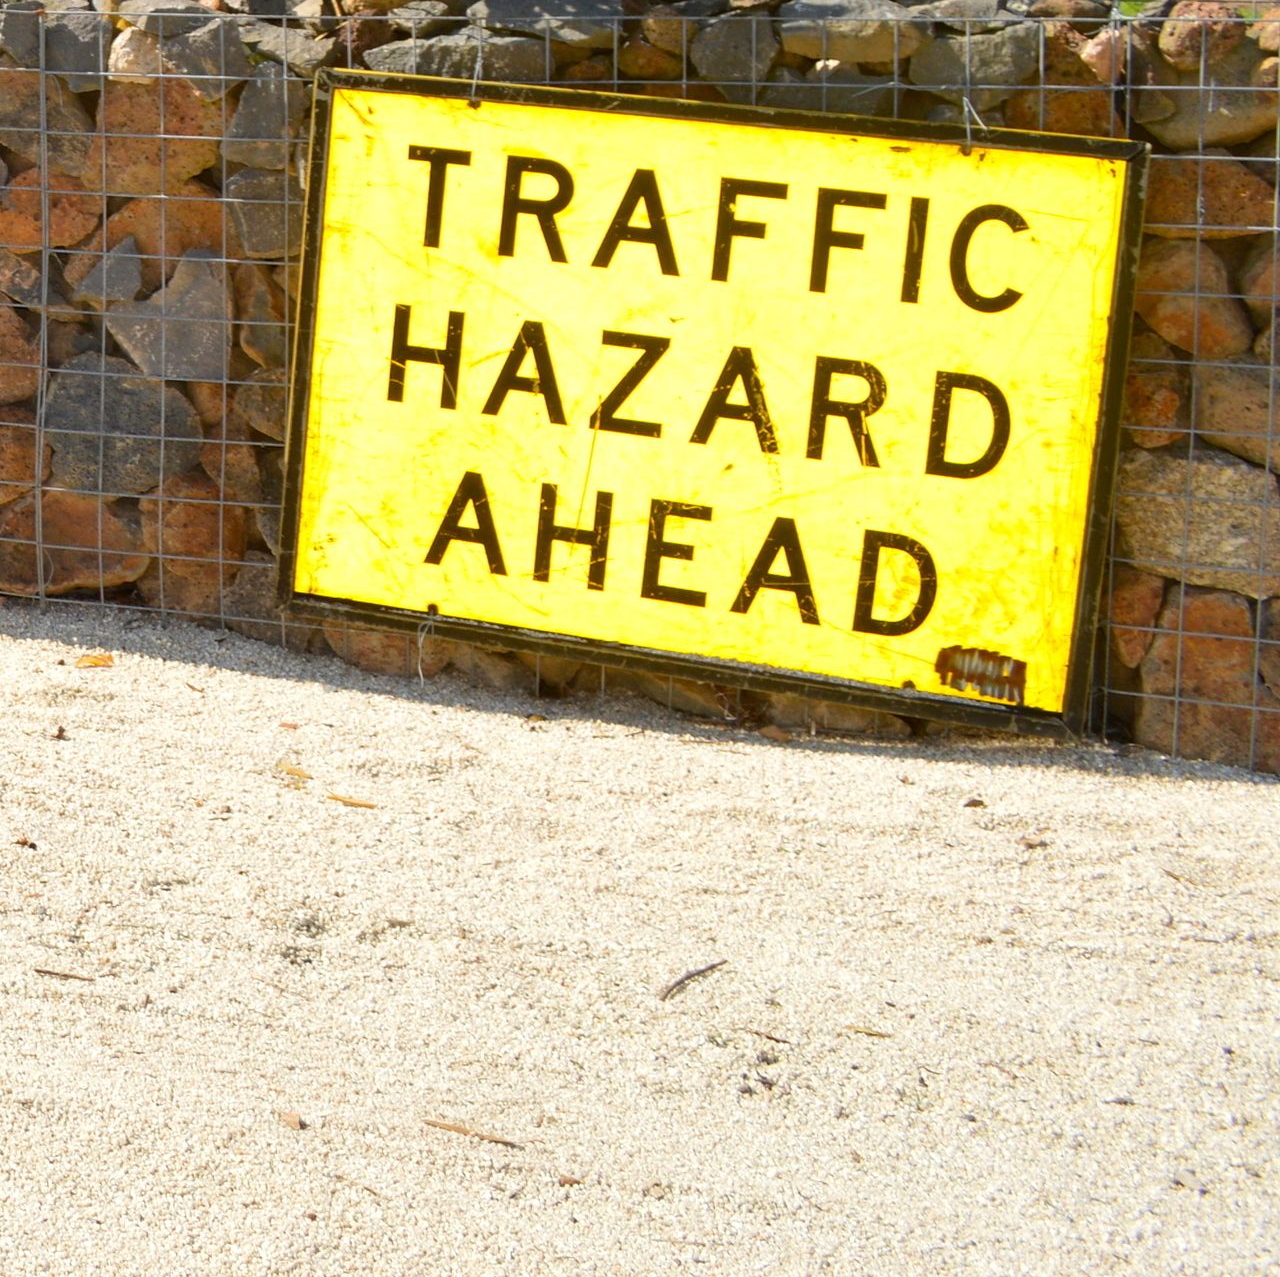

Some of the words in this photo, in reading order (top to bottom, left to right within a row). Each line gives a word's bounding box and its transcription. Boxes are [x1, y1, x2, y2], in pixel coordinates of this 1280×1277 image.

[408, 145, 1029, 313] TRAFFIC
[387, 304, 1011, 479] HAZARD
[425, 472, 938, 636] AHEAD
